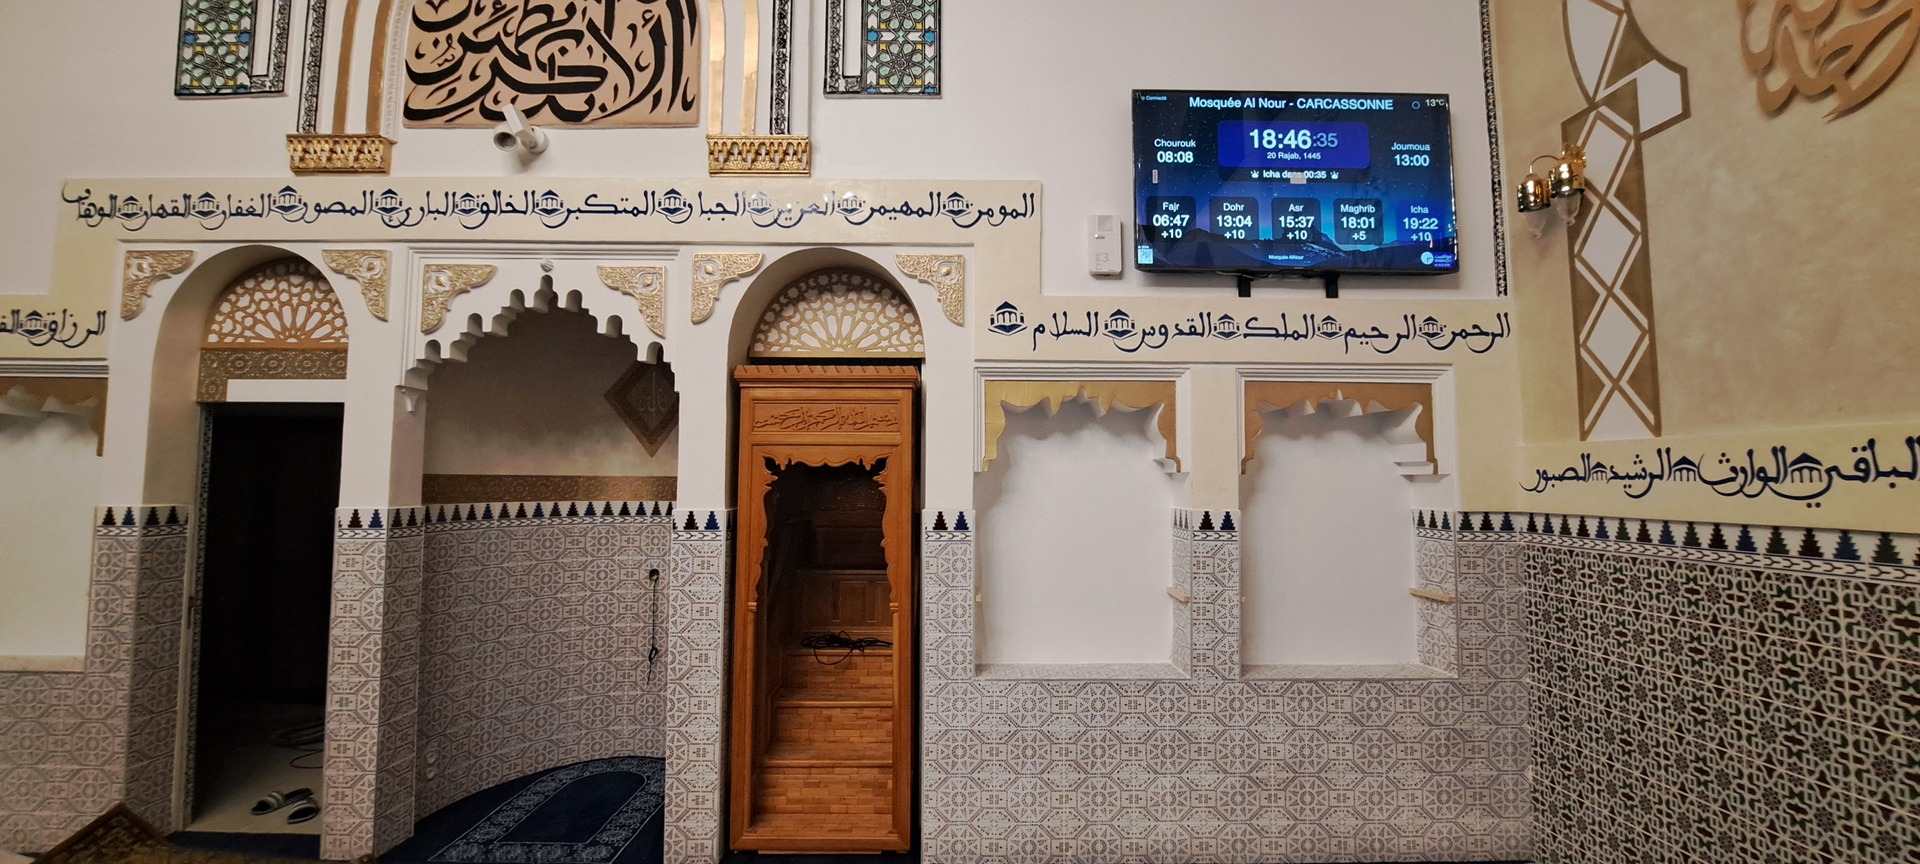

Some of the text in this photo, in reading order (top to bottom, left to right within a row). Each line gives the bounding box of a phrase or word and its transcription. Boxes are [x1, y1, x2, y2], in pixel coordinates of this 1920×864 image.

[1189, 97, 1242, 110] Mosquée
[1258, 98, 1286, 109] Nour
[1296, 98, 1394, 110] CARCASSONNE
[1425, 99, 1445, 107] 13°C
[1154, 139, 1196, 148] Chourouk
[1391, 142, 1431, 151] Joumoua
[1157, 151, 1194, 163] 08:08
[1278, 152, 1301, 161] Rajab,
[1303, 152, 1321, 160] 1445
[1394, 154, 1430, 167] 13:00
[1263, 170, 1281, 178] Icha
[1303, 171, 1327, 179] 00:35
[1162, 202, 1180, 213] Fajr
[1223, 203, 1245, 212] Dohr
[1288, 203, 1304, 213] Asr
[1340, 204, 1376, 215] Maghrib
[1410, 205, 1429, 214] Icha
[1152, 214, 1190, 227] 06:47
[1216, 215, 1253, 228] 13:04
[1278, 215, 1315, 228] 15:37
[1341, 216, 1376, 229] 18:01
[1402, 217, 1439, 230] 19:22
[1161, 229, 1182, 239] +10
[1224, 229, 1245, 240] +10
[1286, 230, 1308, 240] +10
[1352, 231, 1366, 241] +5
[1410, 231, 1432, 242] +10
